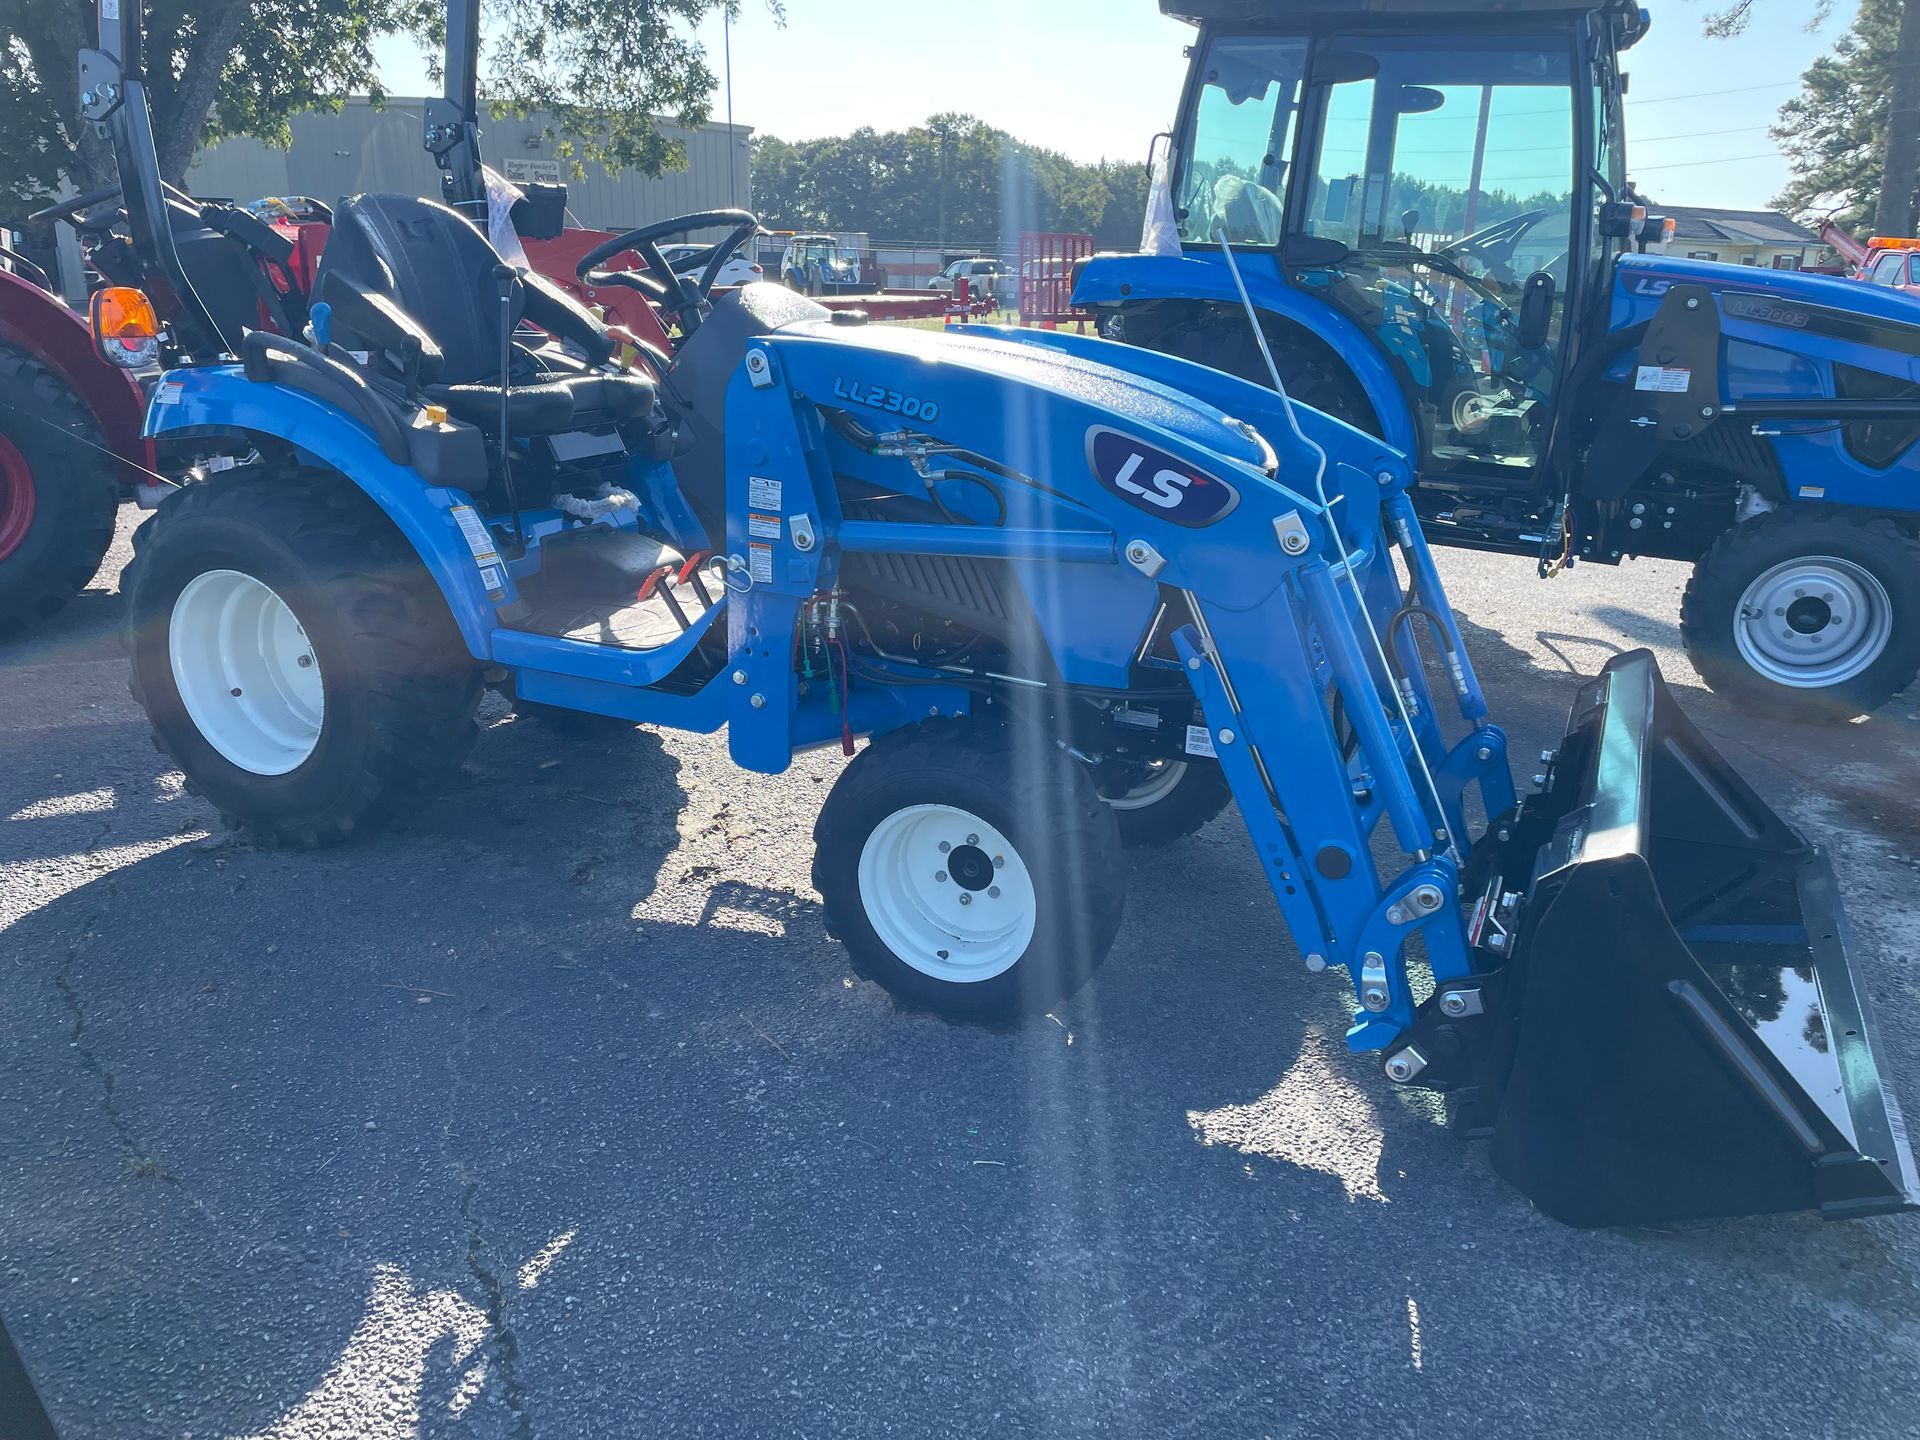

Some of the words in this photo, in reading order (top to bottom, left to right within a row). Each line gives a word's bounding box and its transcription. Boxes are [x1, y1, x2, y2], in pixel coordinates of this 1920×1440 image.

[507, 169, 525, 181] Sales
[534, 170, 558, 182] Service
[1635, 278, 1671, 295] LS
[833, 376, 939, 421] LL2300
[1114, 452, 1192, 509] LS
